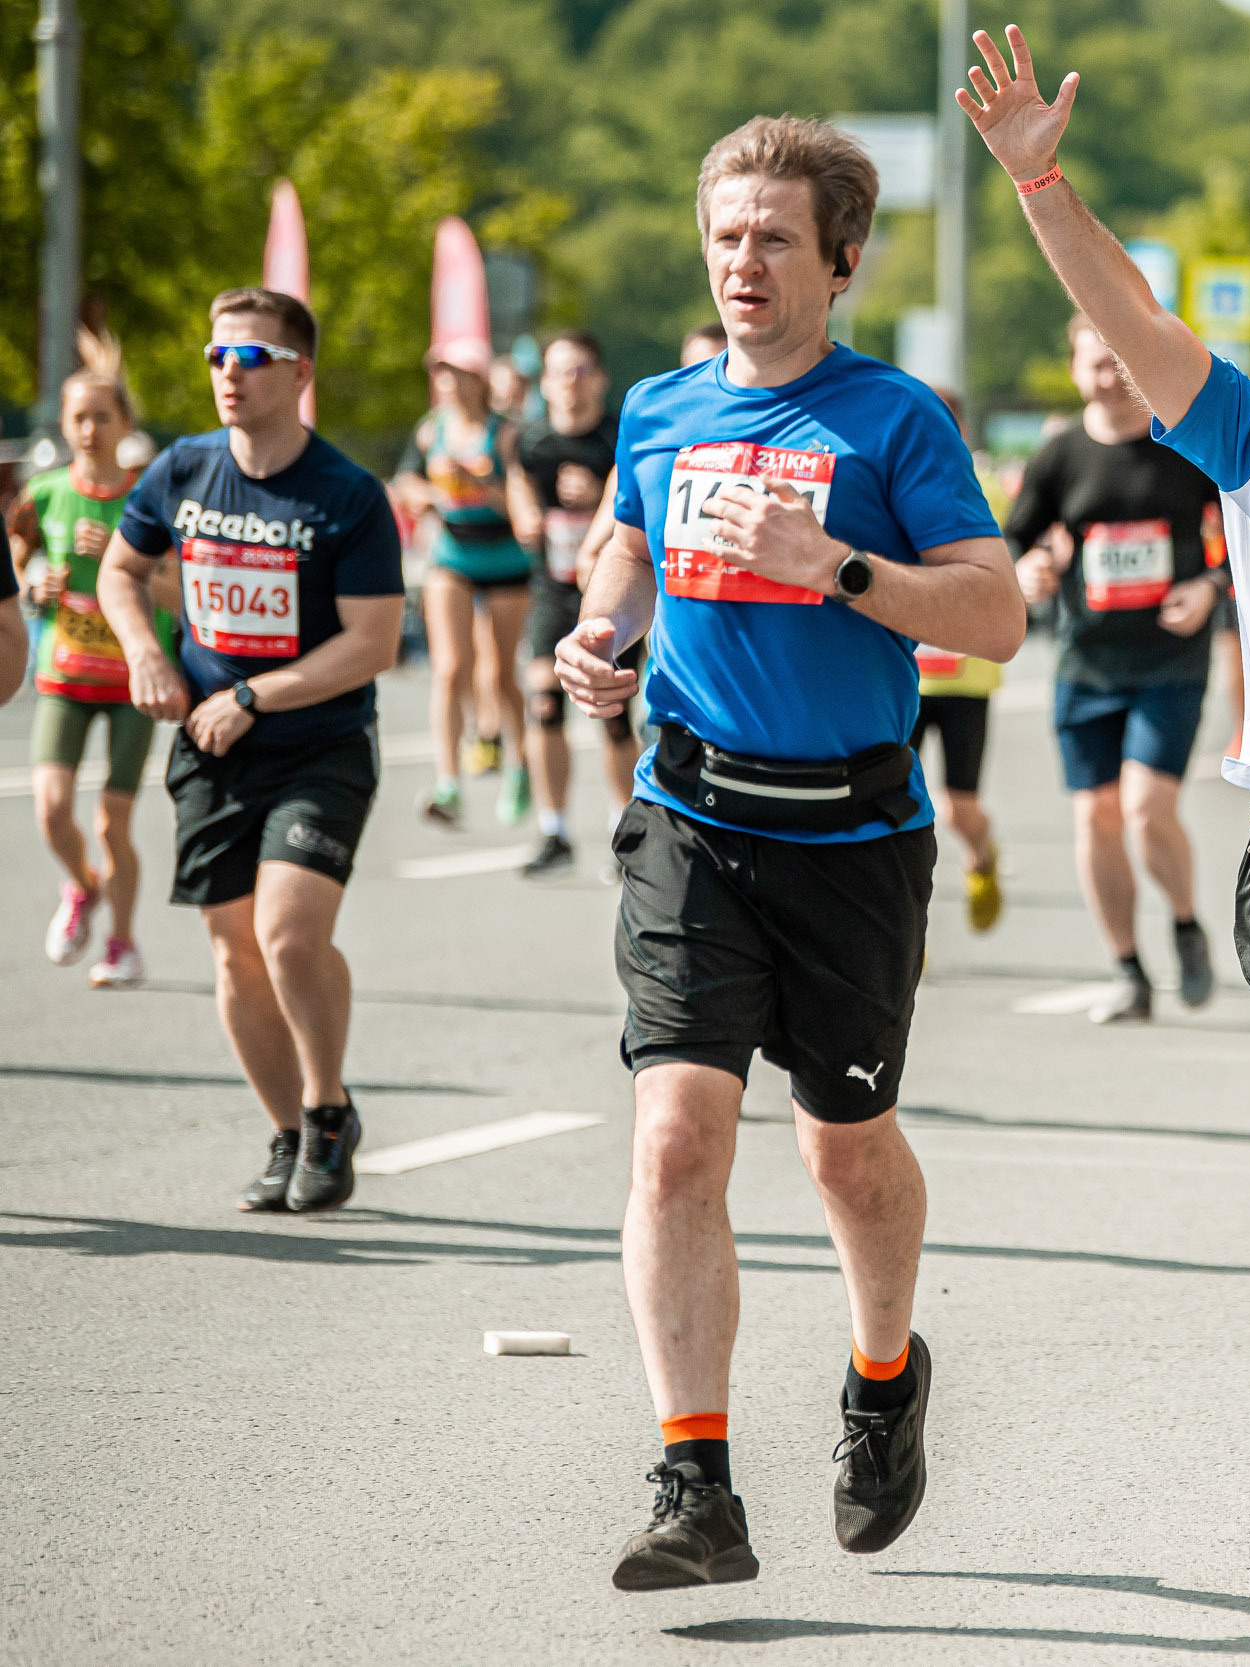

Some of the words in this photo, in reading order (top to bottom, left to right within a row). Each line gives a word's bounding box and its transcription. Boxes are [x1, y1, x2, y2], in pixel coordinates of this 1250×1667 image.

[1034, 171, 1059, 189] 15680
[173, 499, 315, 550] Reebok
[678, 551, 693, 577] F
[191, 580, 290, 618] 15043
